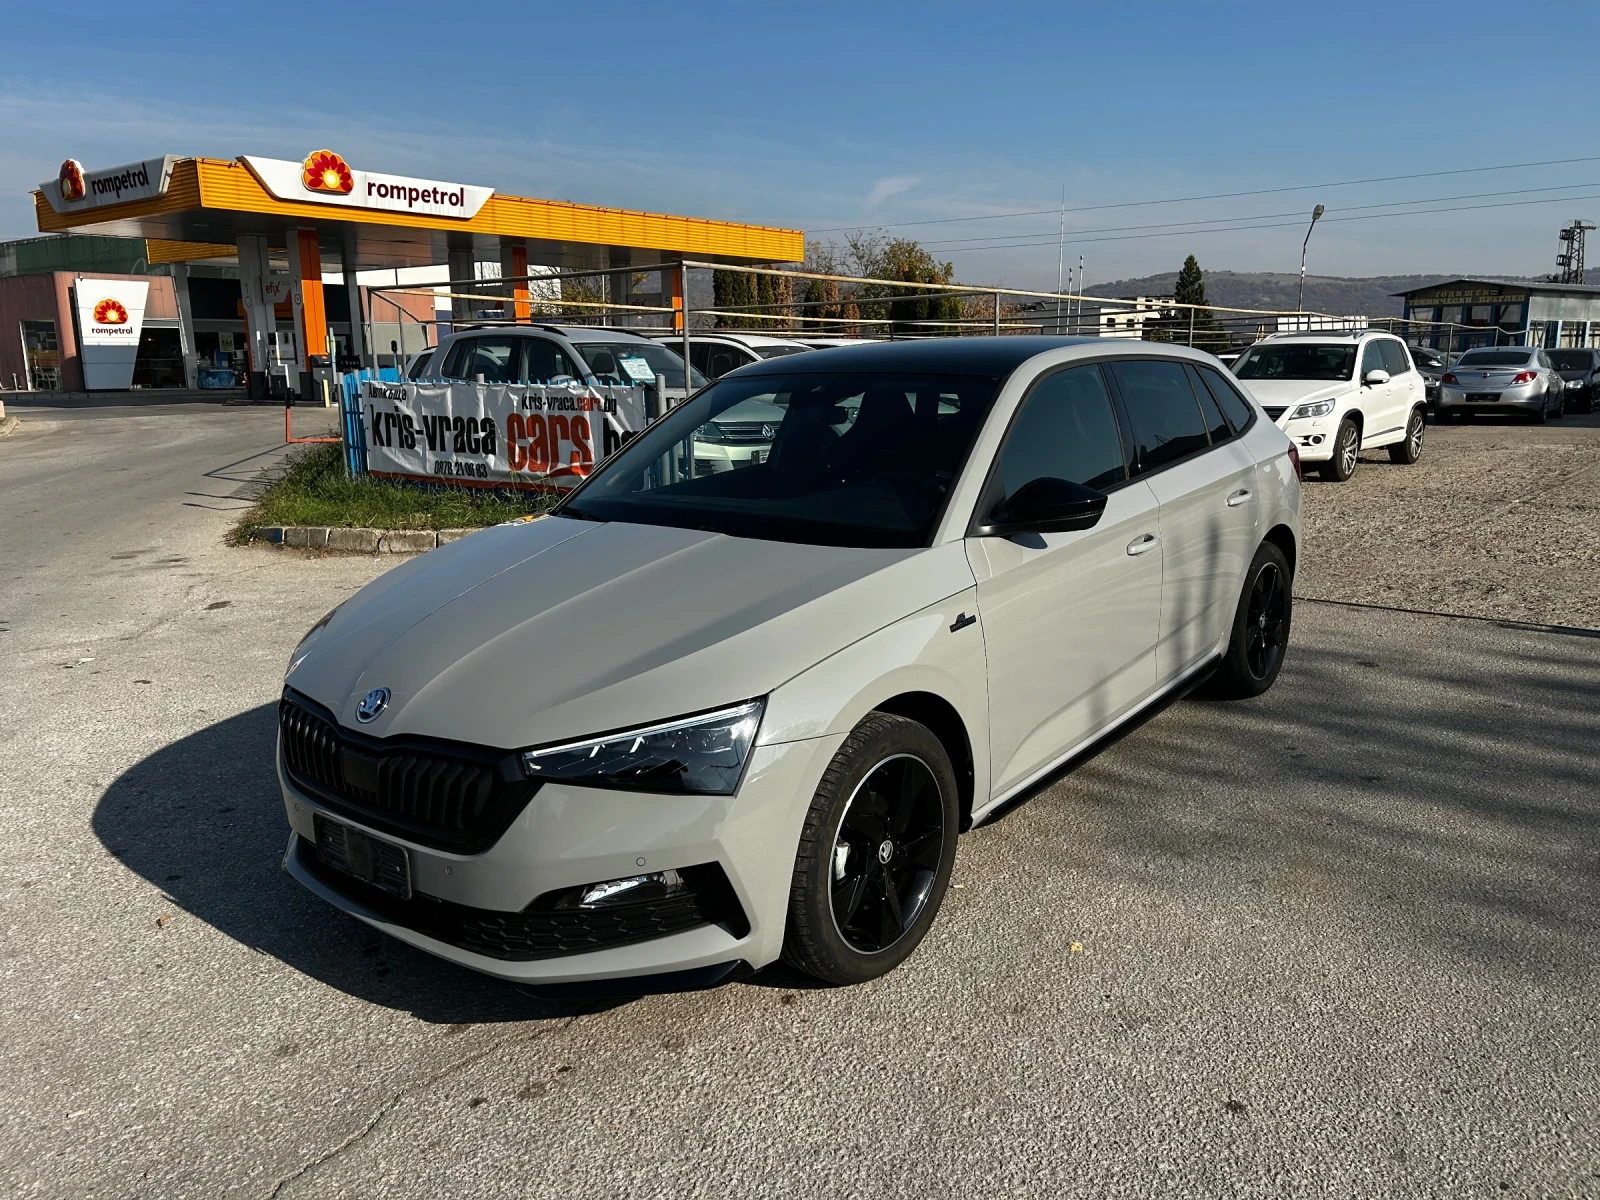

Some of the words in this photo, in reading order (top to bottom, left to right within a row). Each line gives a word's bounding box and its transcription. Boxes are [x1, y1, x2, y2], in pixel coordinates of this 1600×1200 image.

[91, 162, 149, 198] rompetrol
[367, 181, 464, 208] rompetrol
[1478, 294, 1526, 303] ПРЕГЛЕД
[91, 326, 133, 337] rompetrol
[521, 393, 618, 416] kris-vraca.cars.bg
[370, 404, 497, 455] kris-vraca
[506, 413, 594, 476] cars
[602, 417, 641, 458] b
[454, 461, 465, 476] 21
